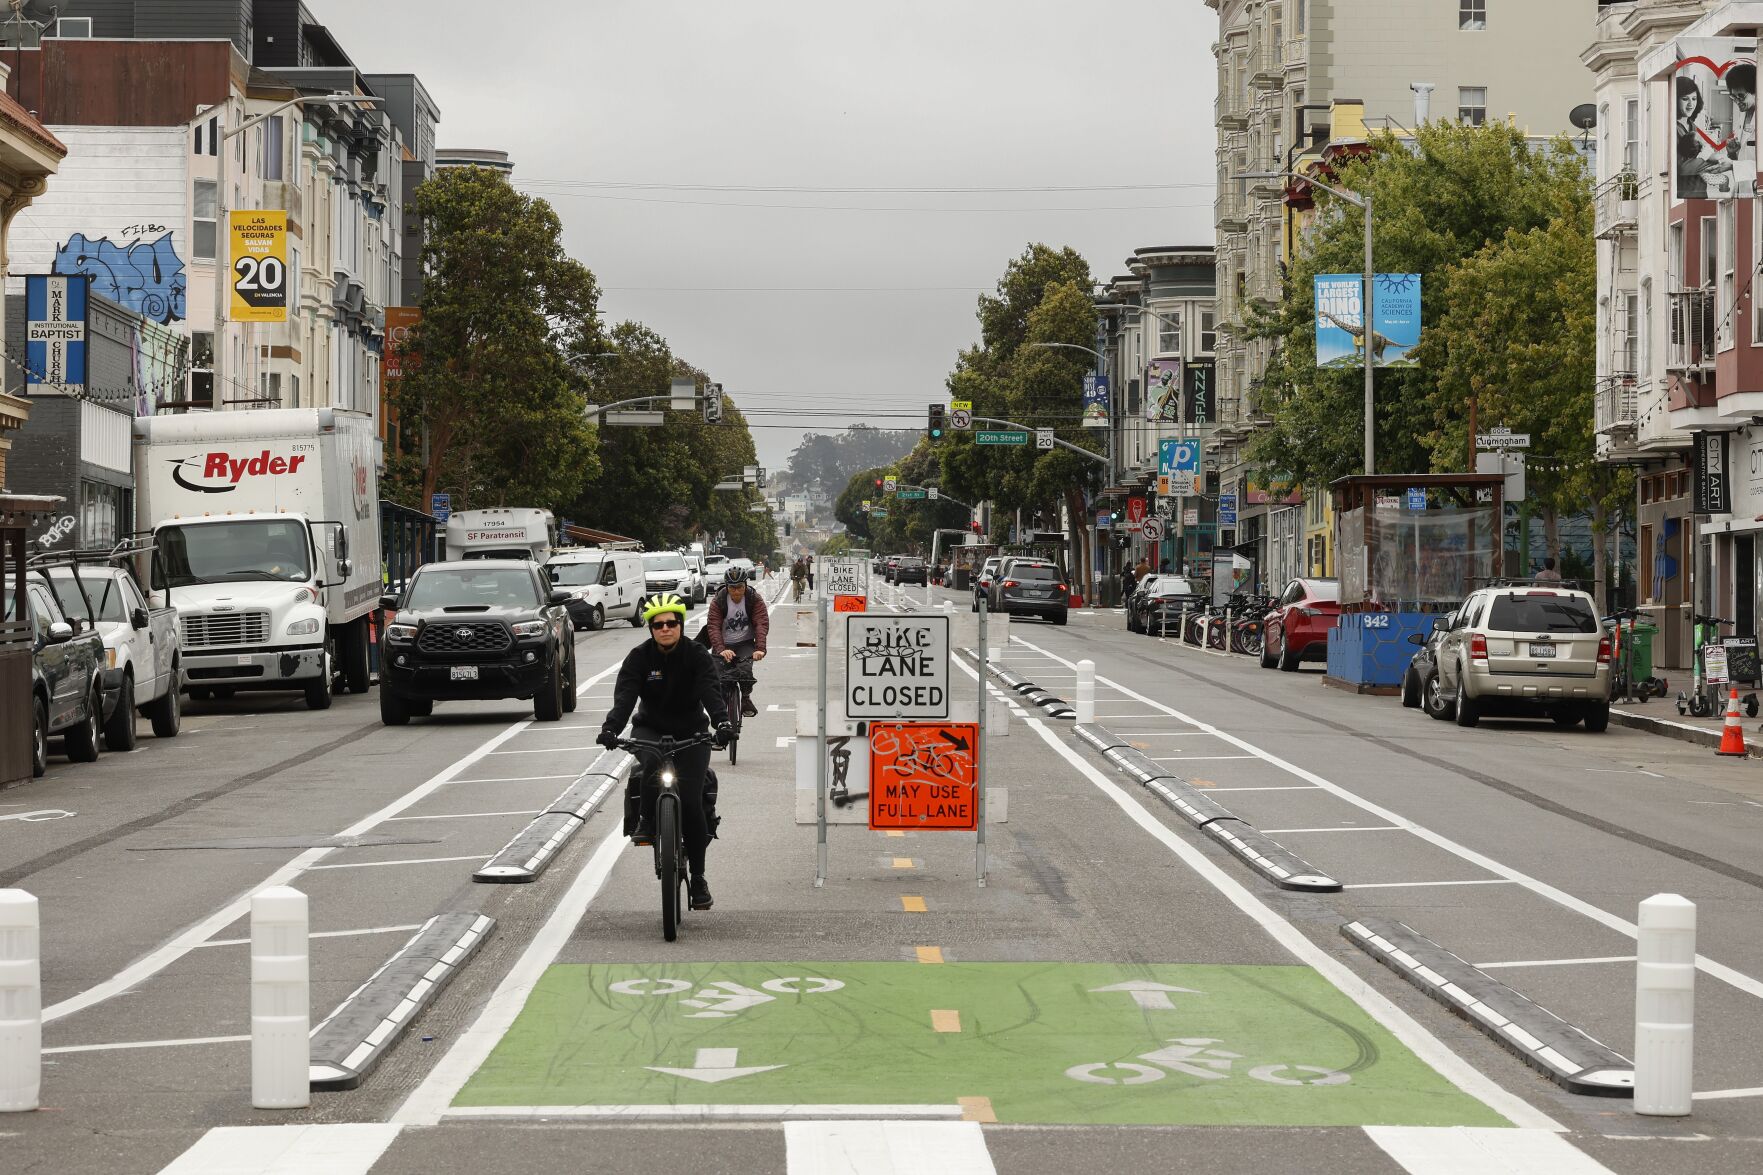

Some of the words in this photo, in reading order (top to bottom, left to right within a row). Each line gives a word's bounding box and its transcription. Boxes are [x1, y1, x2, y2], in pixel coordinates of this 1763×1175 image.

[236, 257, 282, 290] 20
[1318, 288, 1359, 298] LARGEST
[51, 290, 62, 321] MARK
[1318, 297, 1360, 315] DINO
[31, 330, 82, 339] BAPTIST
[52, 341, 61, 383] CHURCH
[1195, 370, 1206, 424] SFJAZZ
[979, 434, 998, 442] 20th
[999, 434, 1023, 442] Street
[1039, 438, 1052, 446] 20
[292, 444, 315, 452] 815775
[1709, 438, 1719, 471] CITY
[204, 450, 305, 483] Ryder
[1710, 476, 1721, 507] ART
[467, 532, 478, 540] SF
[480, 531, 525, 540] Paratransit
[828, 584, 857, 592] CLOSED
[866, 627, 930, 647] BIKE
[862, 657, 934, 677] LANE
[852, 685, 943, 706] CLOSED
[886, 785, 920, 799] MAY
[930, 785, 960, 799] USE
[878, 804, 918, 818] FULL
[926, 804, 968, 818] LANE
